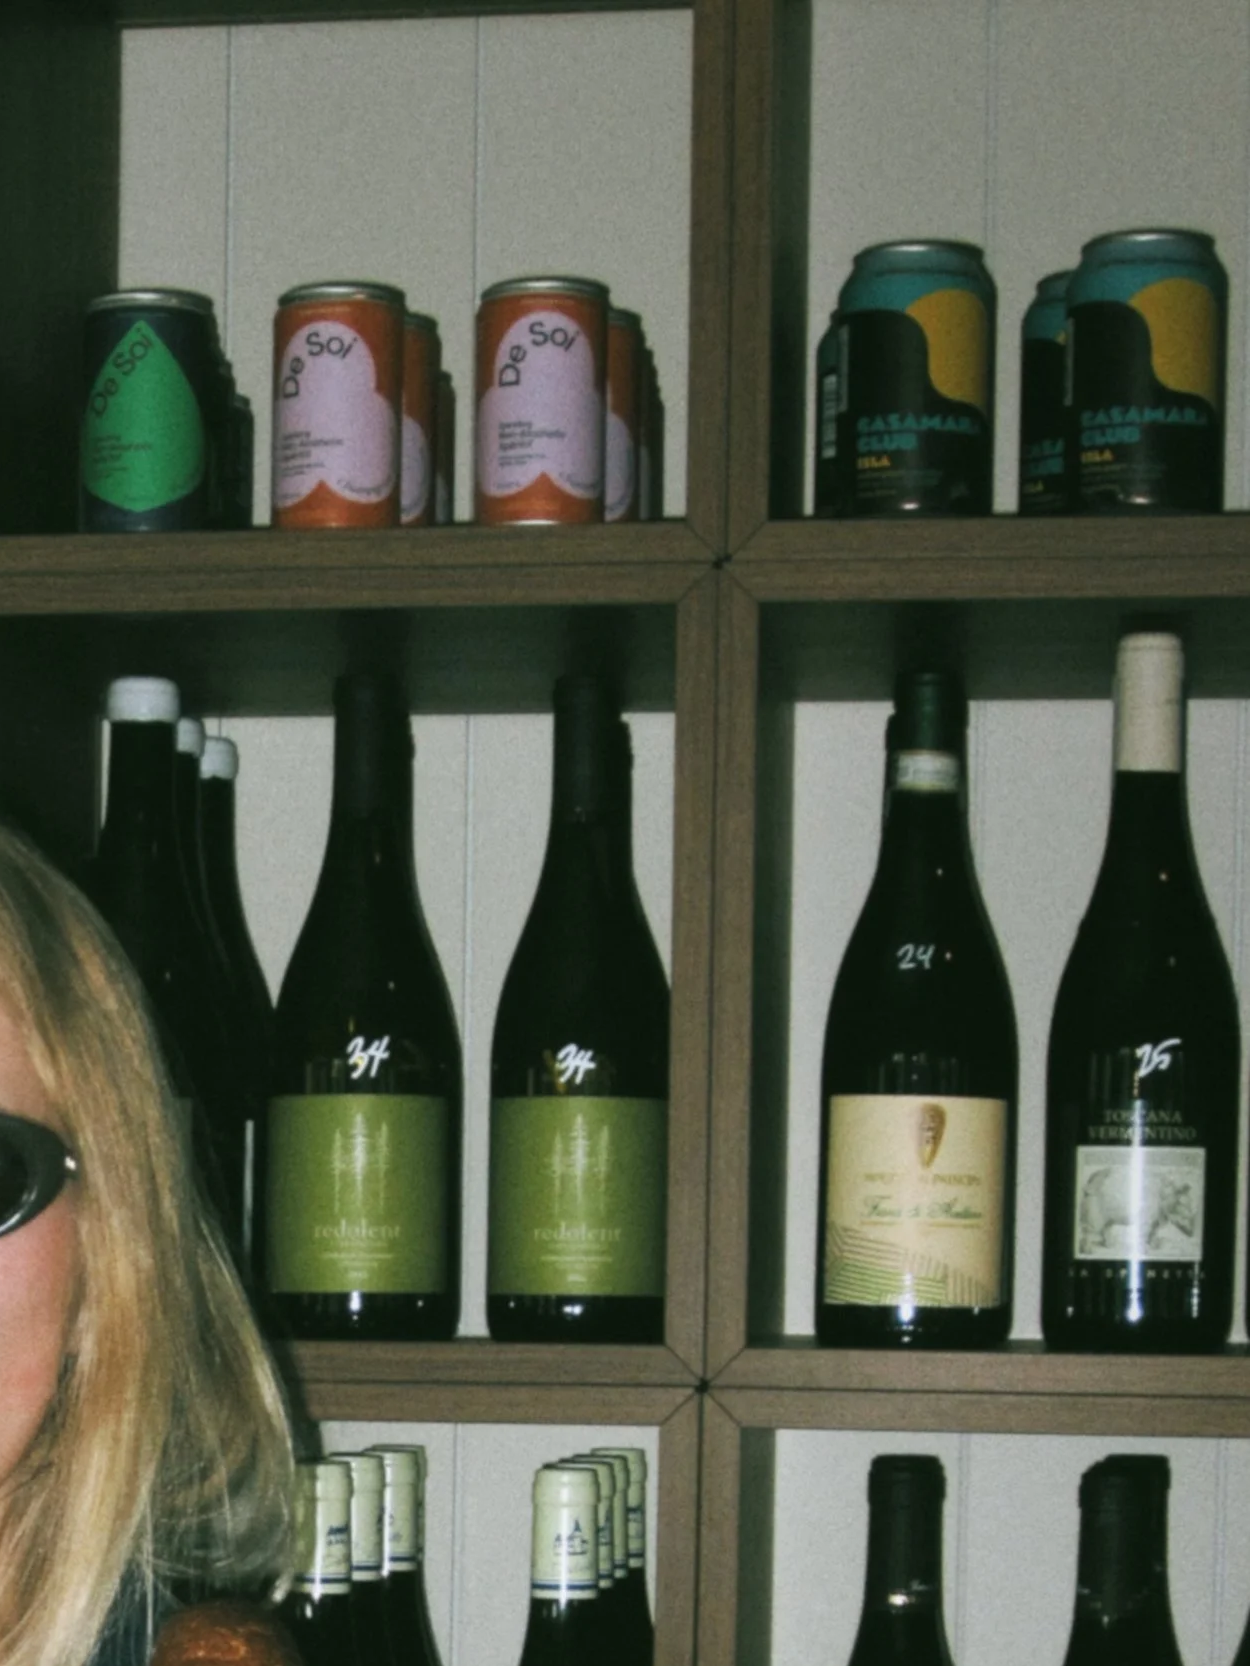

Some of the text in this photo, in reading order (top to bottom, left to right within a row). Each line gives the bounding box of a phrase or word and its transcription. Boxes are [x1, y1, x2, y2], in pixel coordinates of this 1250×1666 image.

[91, 327, 154, 417] De Soi
[282, 332, 359, 399] De Soi
[499, 321, 580, 388] De Soi
[896, 943, 936, 970] 24
